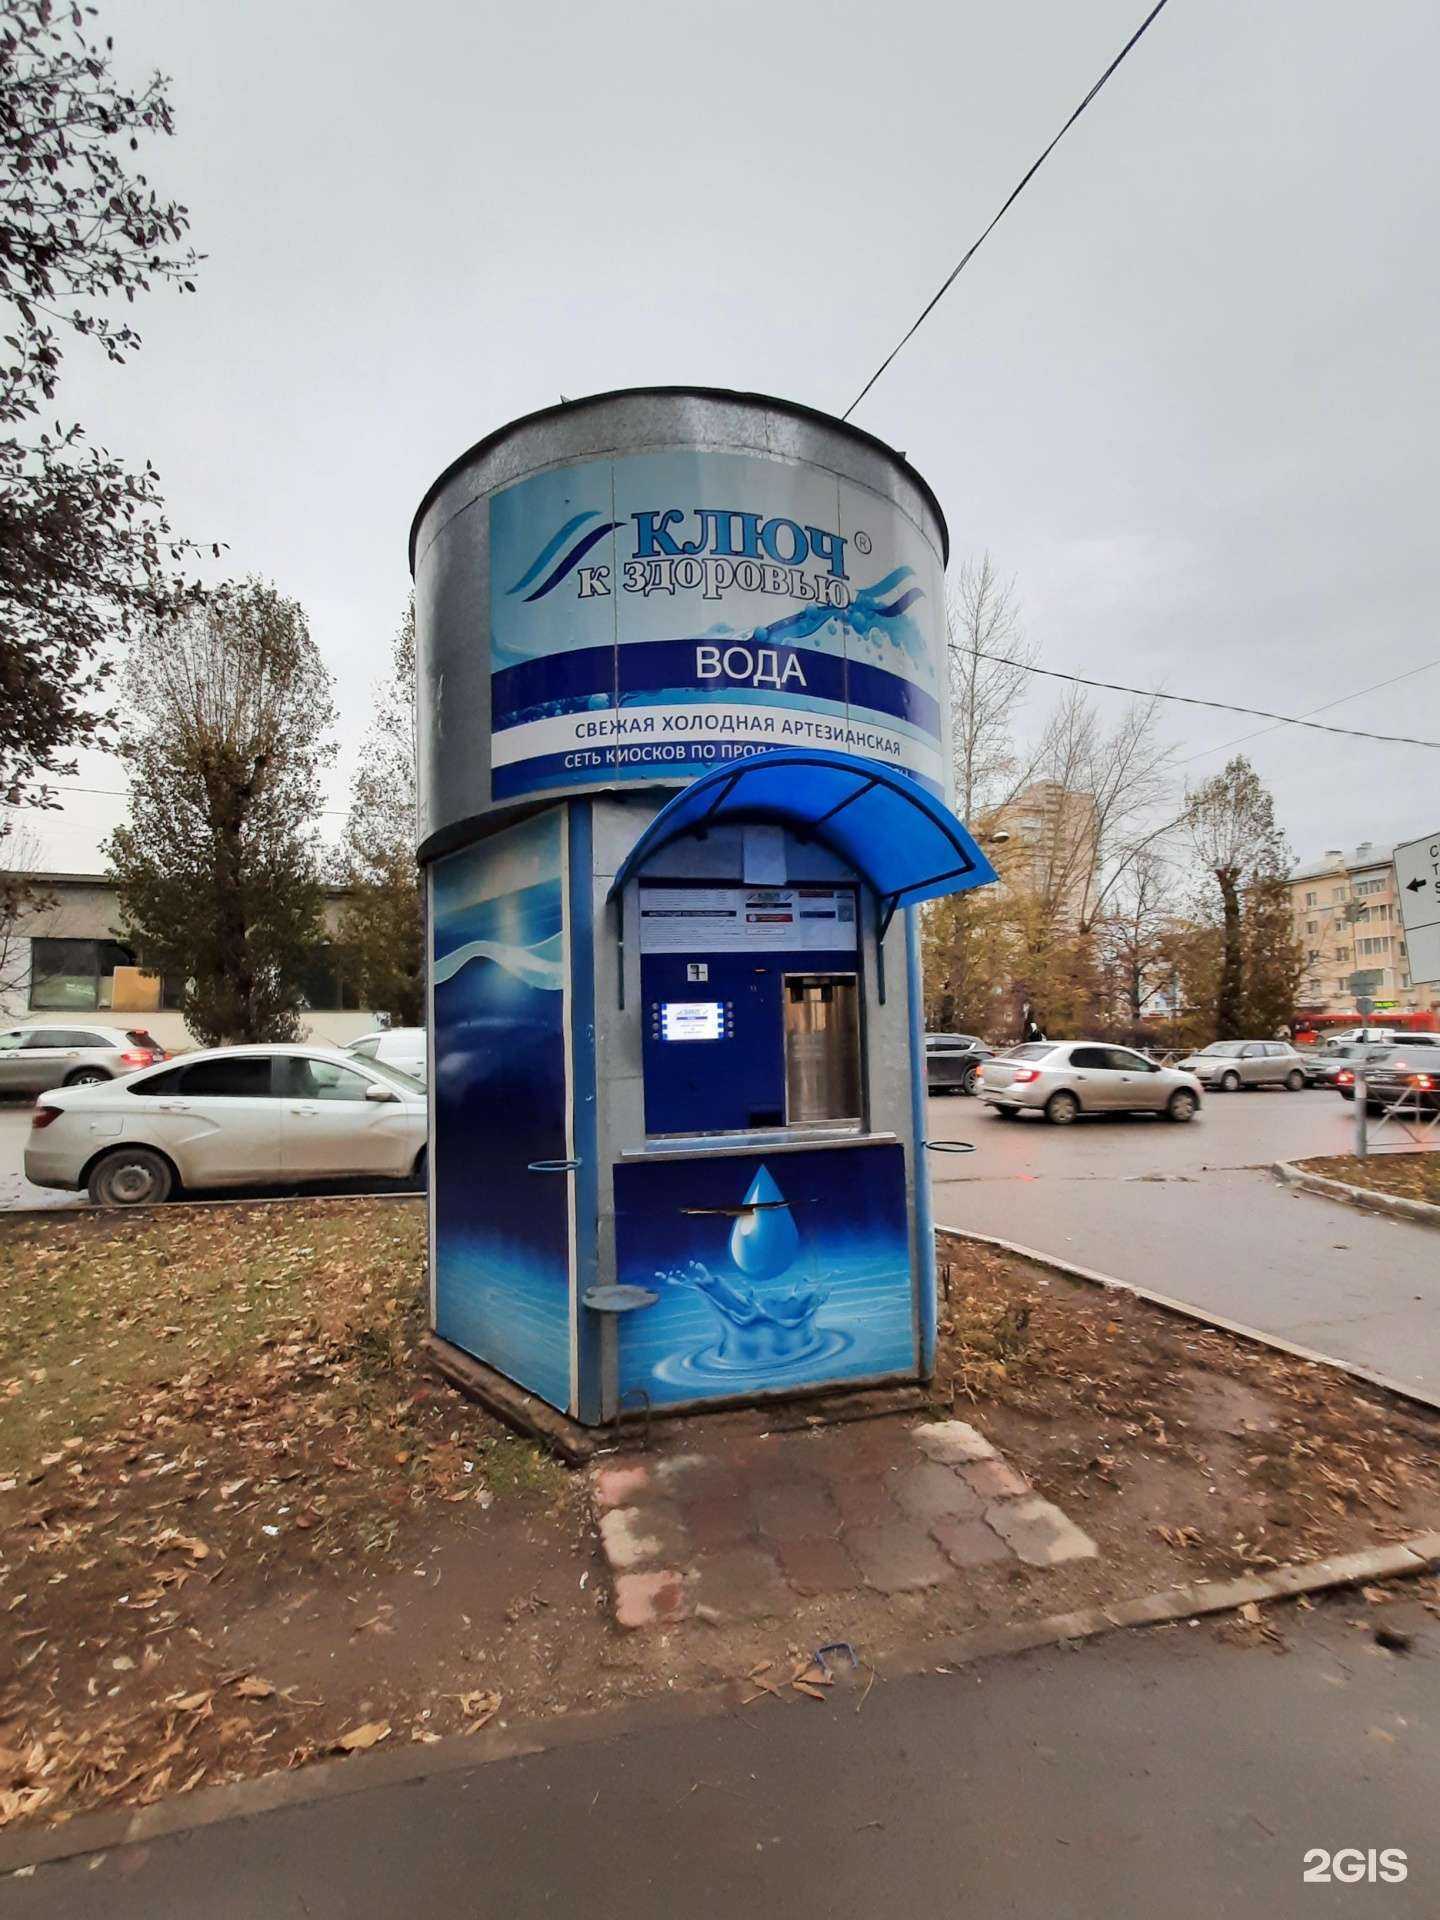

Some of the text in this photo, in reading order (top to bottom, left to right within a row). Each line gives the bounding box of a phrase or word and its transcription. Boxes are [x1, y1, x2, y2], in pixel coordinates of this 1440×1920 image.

[631, 509, 850, 580] КЛЮЧ
[696, 646, 807, 688] ВОДА
[575, 714, 900, 756] СВЕЖАЯ ХОЛОДНАЯ АРТЕЗИАНСКАЯ
[564, 753, 601, 768] СЕТЬ
[606, 745, 686, 763] КИОСКОВ
[691, 745, 716, 758] ПО
